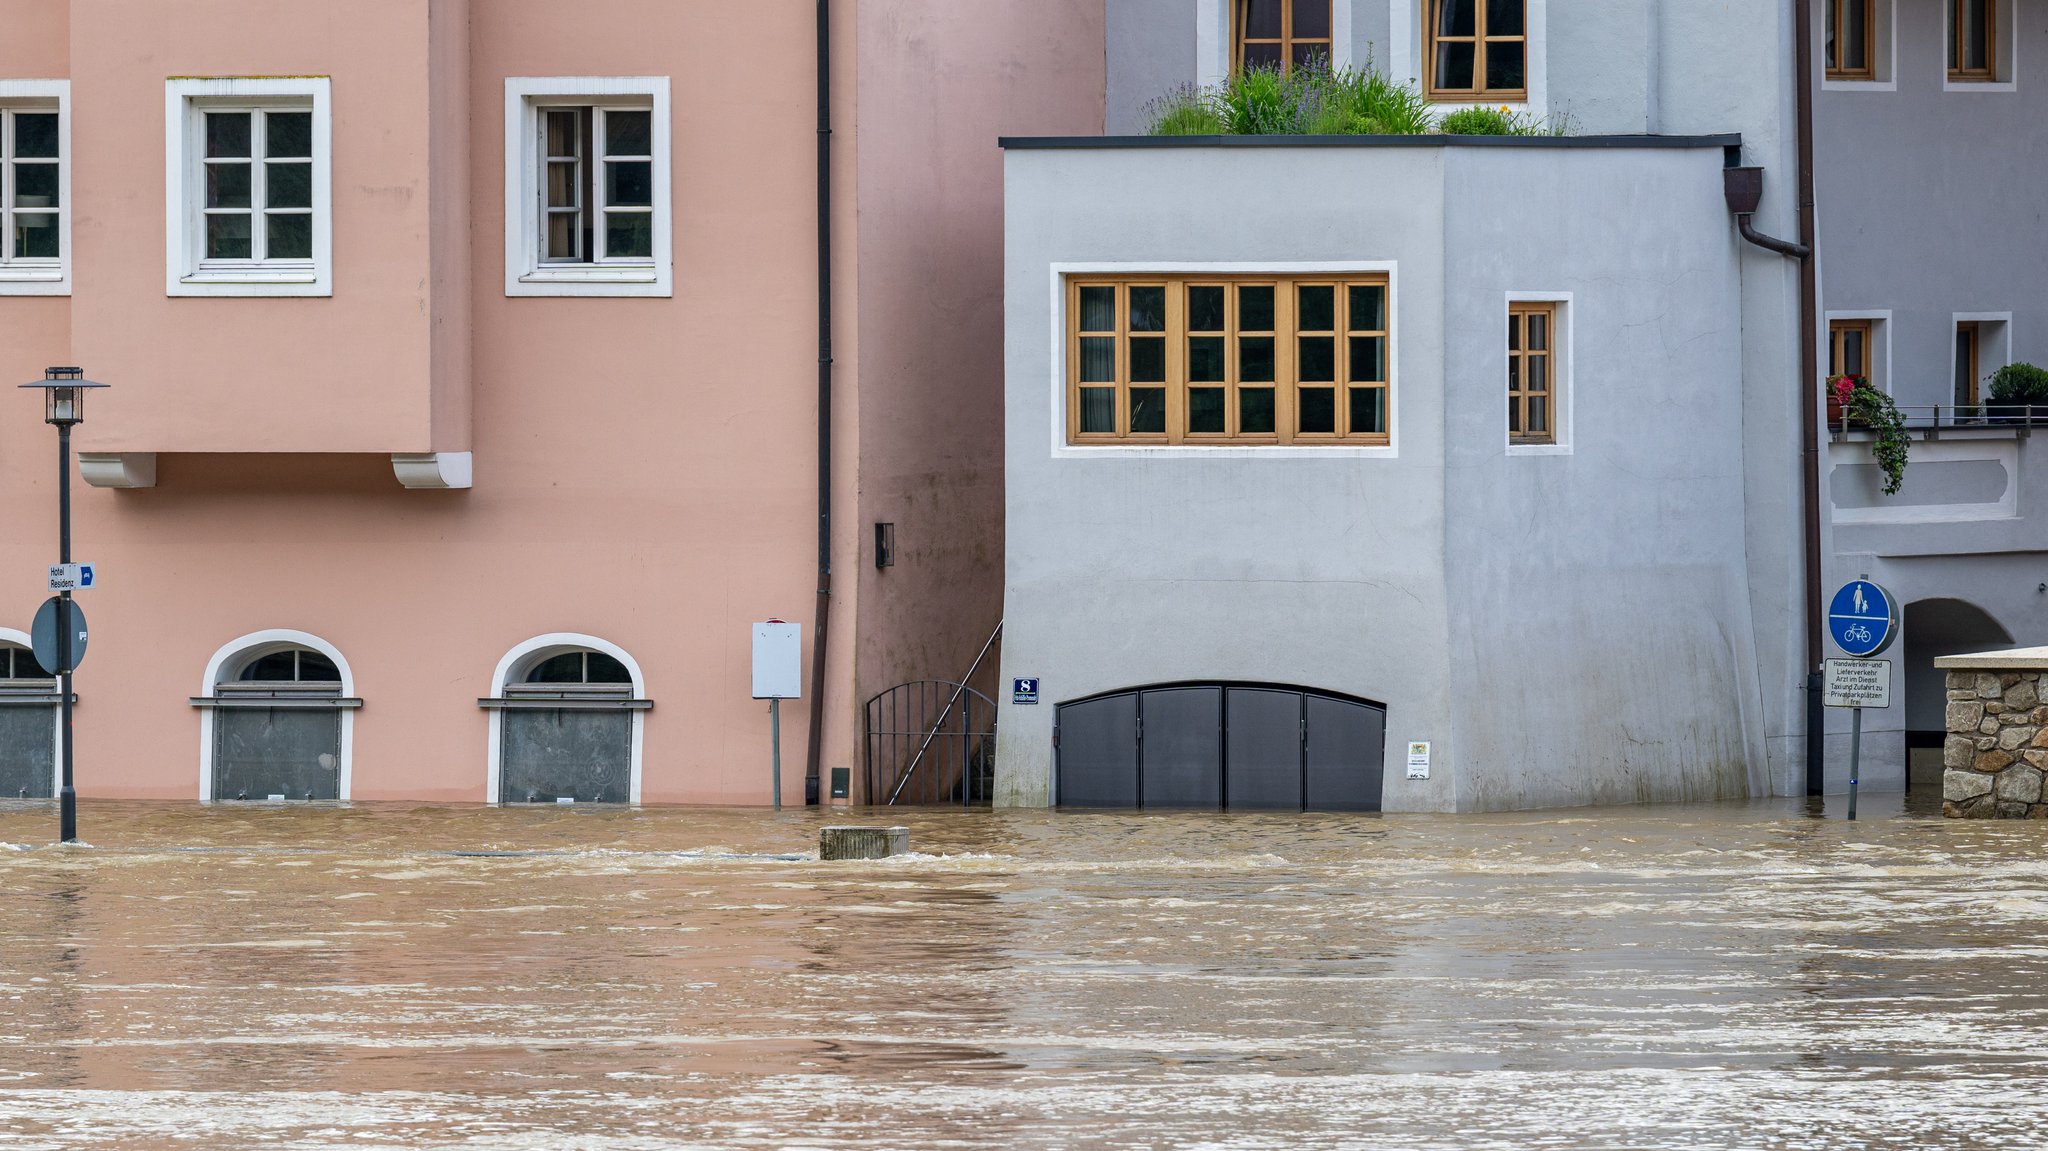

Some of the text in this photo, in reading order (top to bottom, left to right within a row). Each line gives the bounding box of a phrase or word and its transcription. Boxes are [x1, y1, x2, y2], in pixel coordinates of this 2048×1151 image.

[51, 567, 65, 576] Hotel
[51, 579, 74, 588] Residenz
[1020, 680, 1031, 692] 8
[1831, 691, 1882, 699] Privatparkplätzen
